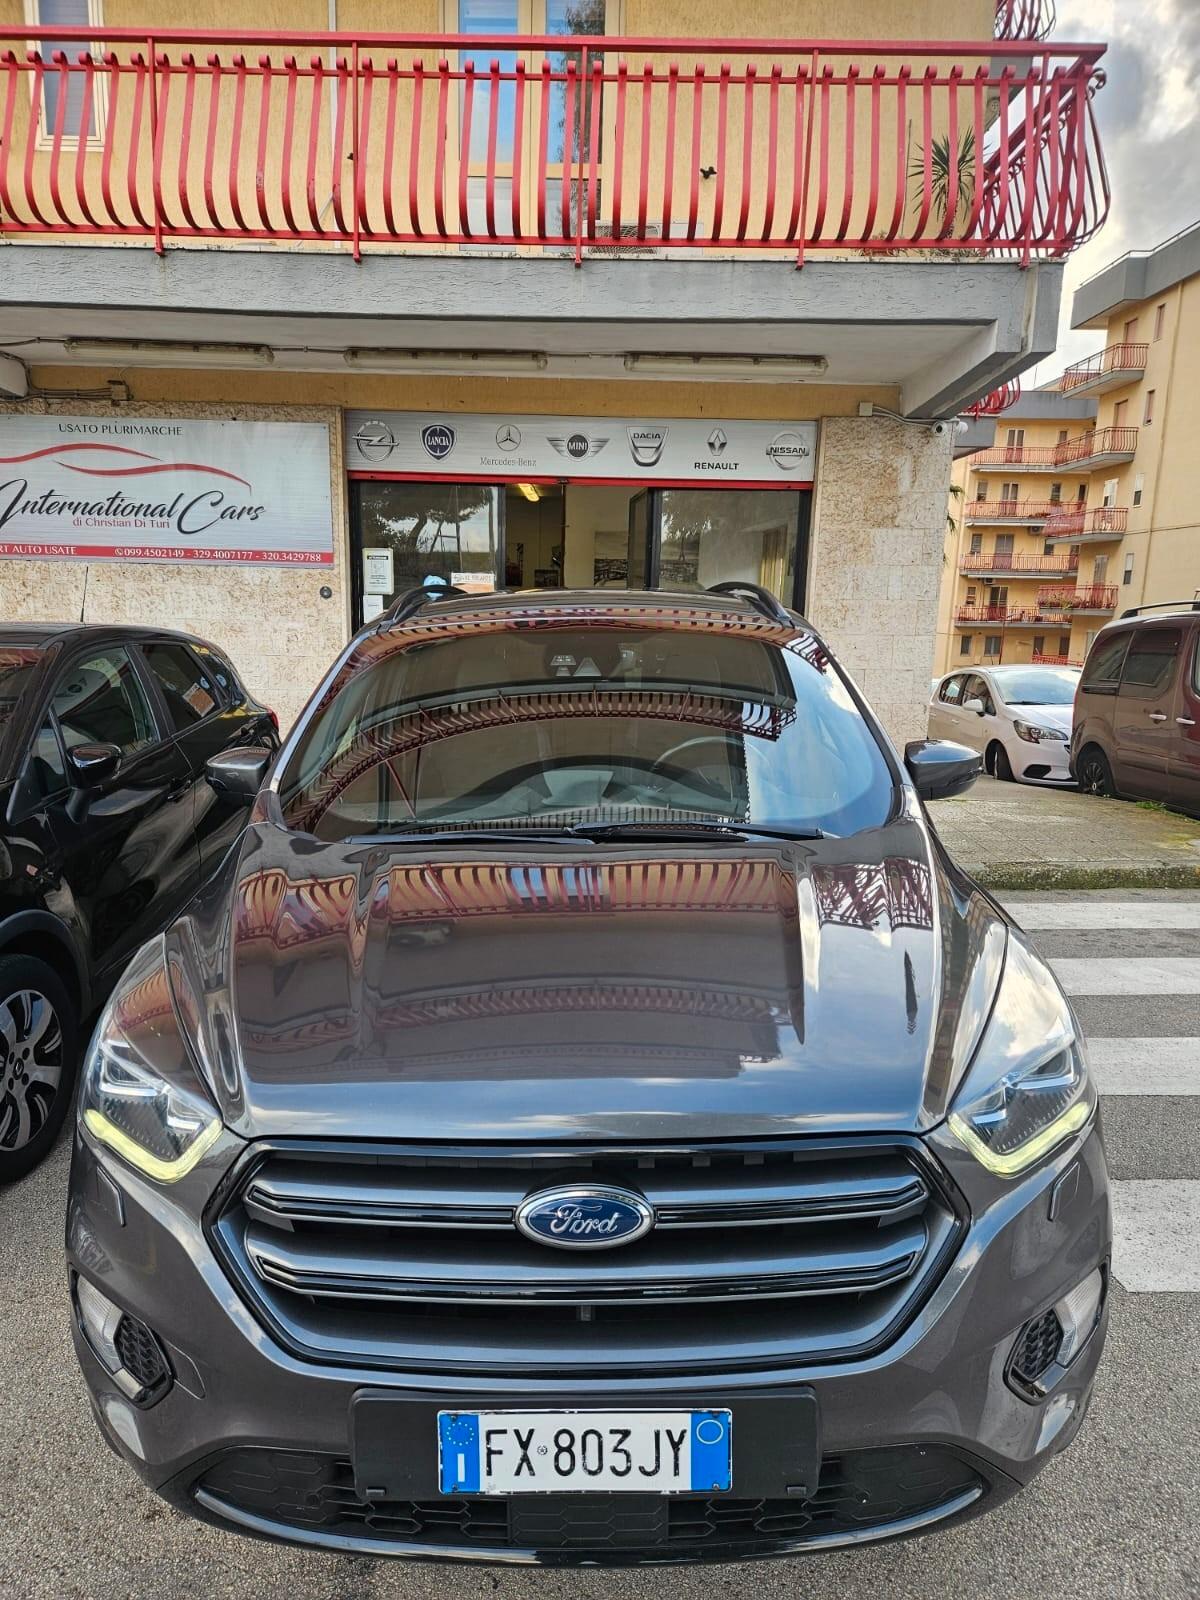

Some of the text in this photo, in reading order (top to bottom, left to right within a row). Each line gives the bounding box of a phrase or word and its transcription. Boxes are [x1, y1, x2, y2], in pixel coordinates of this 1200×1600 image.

[58, 423, 184, 436] USATO PLURIMARCHE
[427, 435, 450, 447] LANCIA
[633, 432, 661, 440] DACIA
[568, 440, 588, 451] MINI
[770, 446, 806, 454] NISSAN
[480, 456, 537, 467] Mercedes-Benz
[694, 462, 740, 471] RENAULT
[0, 478, 266, 535] International Cars
[72, 517, 170, 529] di Christian Di Turi
[12, 545, 42, 554] AUTO
[44, 546, 77, 555] USATE
[124, 547, 185, 558] 099.4502149
[192, 549, 253, 560] 329.4007177
[261, 551, 322, 562] 320.3429788
[550, 1203, 619, 1234] Ford
